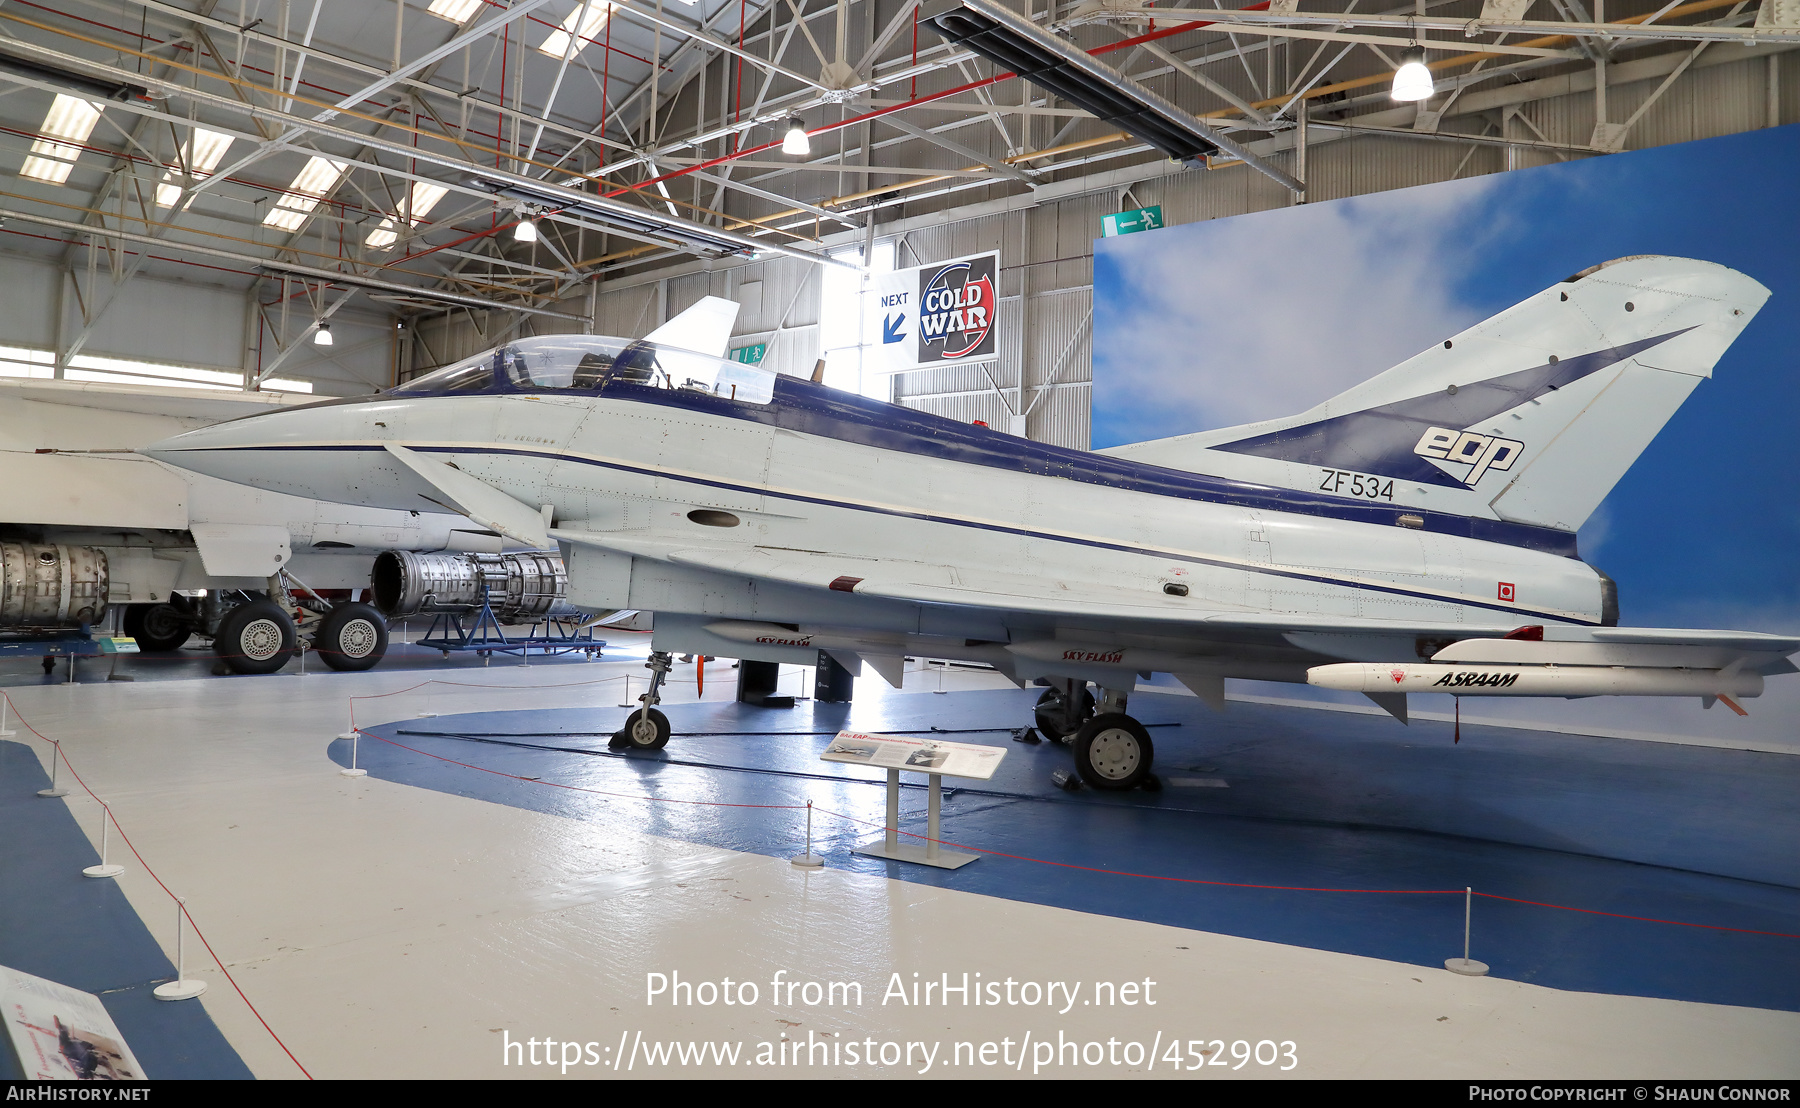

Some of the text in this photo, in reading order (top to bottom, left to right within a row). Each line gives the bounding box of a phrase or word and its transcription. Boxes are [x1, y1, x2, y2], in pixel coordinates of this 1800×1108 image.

[881, 292, 909, 308] NEXT
[926, 285, 982, 312] COLD
[921, 306, 988, 336] WAR
[1319, 468, 1395, 501] ZF534
[1062, 650, 1123, 663] SKY FLASH
[1432, 671, 1520, 688] ASRAAM
